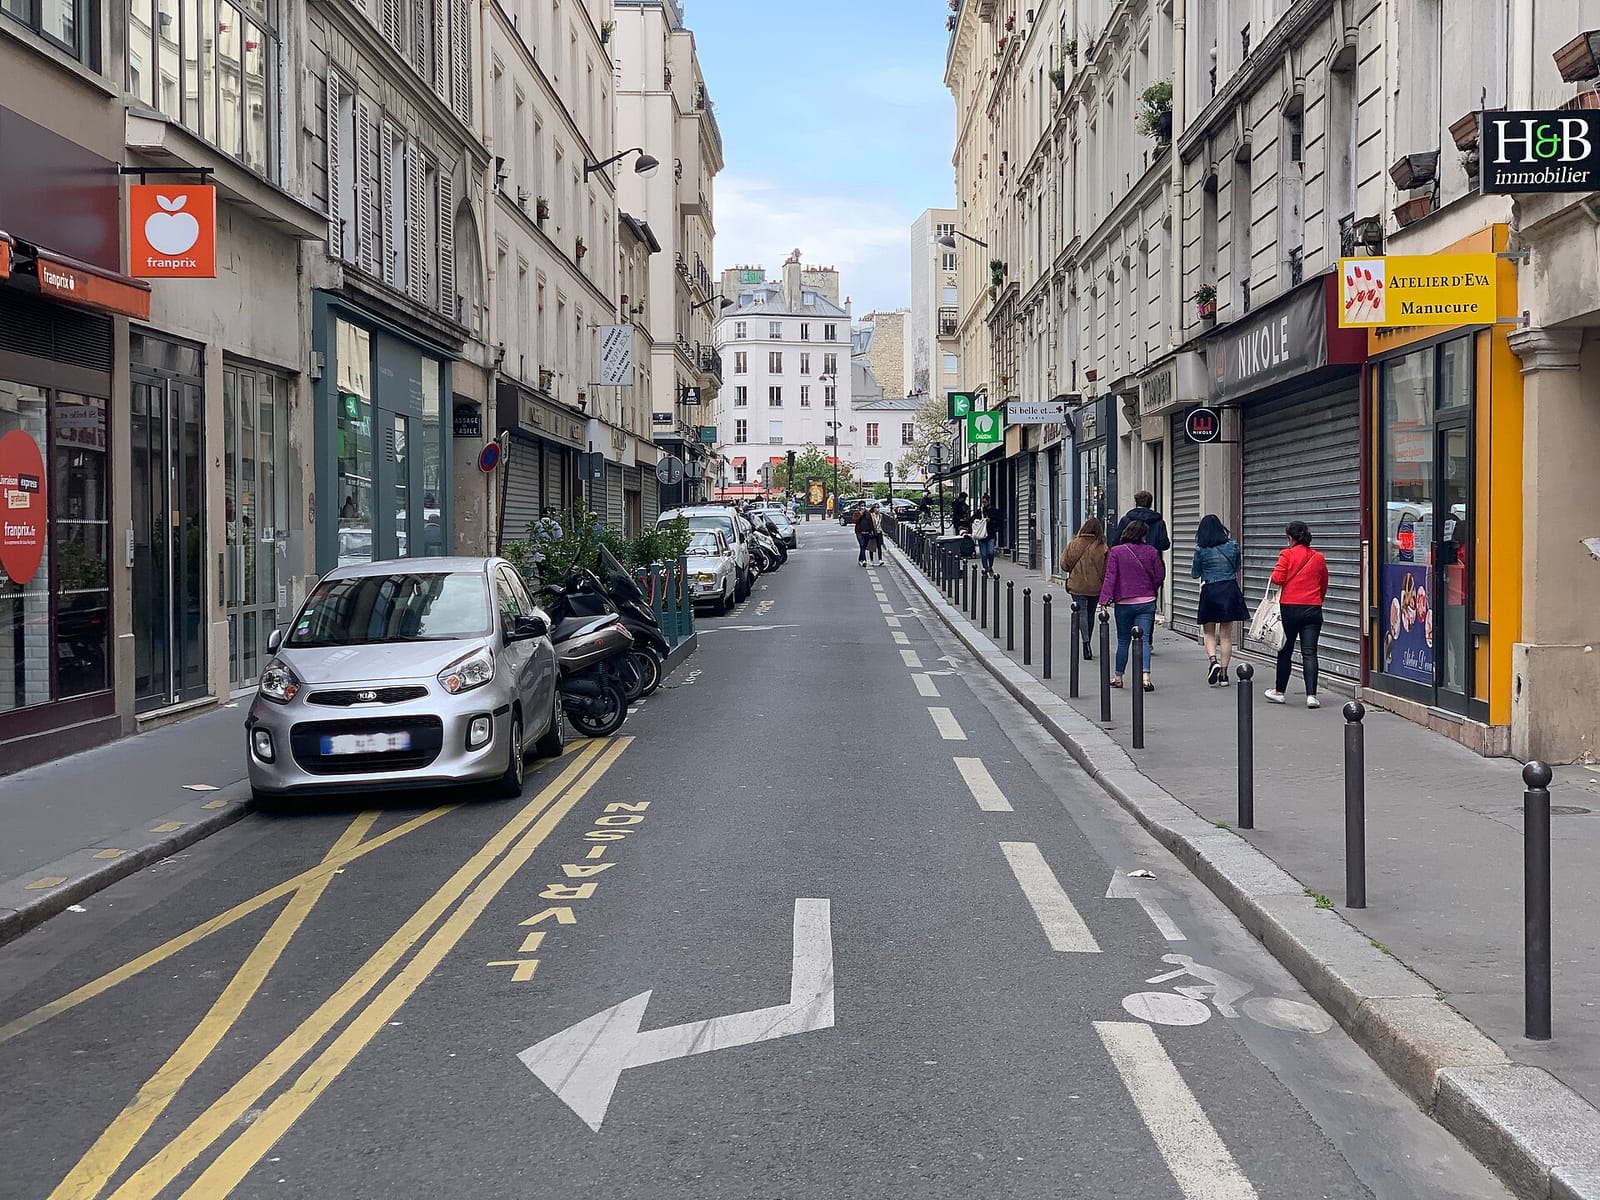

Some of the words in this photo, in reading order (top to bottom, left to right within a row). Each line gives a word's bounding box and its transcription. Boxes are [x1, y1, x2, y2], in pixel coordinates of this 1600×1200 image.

[1492, 118, 1592, 164] H&B
[1494, 166, 1591, 185] immobilier
[146, 256, 197, 269] franprix
[43, 267, 69, 290] franprix
[1389, 275, 1448, 289] ATELIER
[1452, 272, 1490, 288] D'EVA
[1401, 301, 1479, 315] Manucure
[1238, 316, 1289, 379] NIKOLE
[1008, 406, 1017, 415] Si
[1019, 406, 1039, 415] belle
[359, 691, 375, 699] KIA
